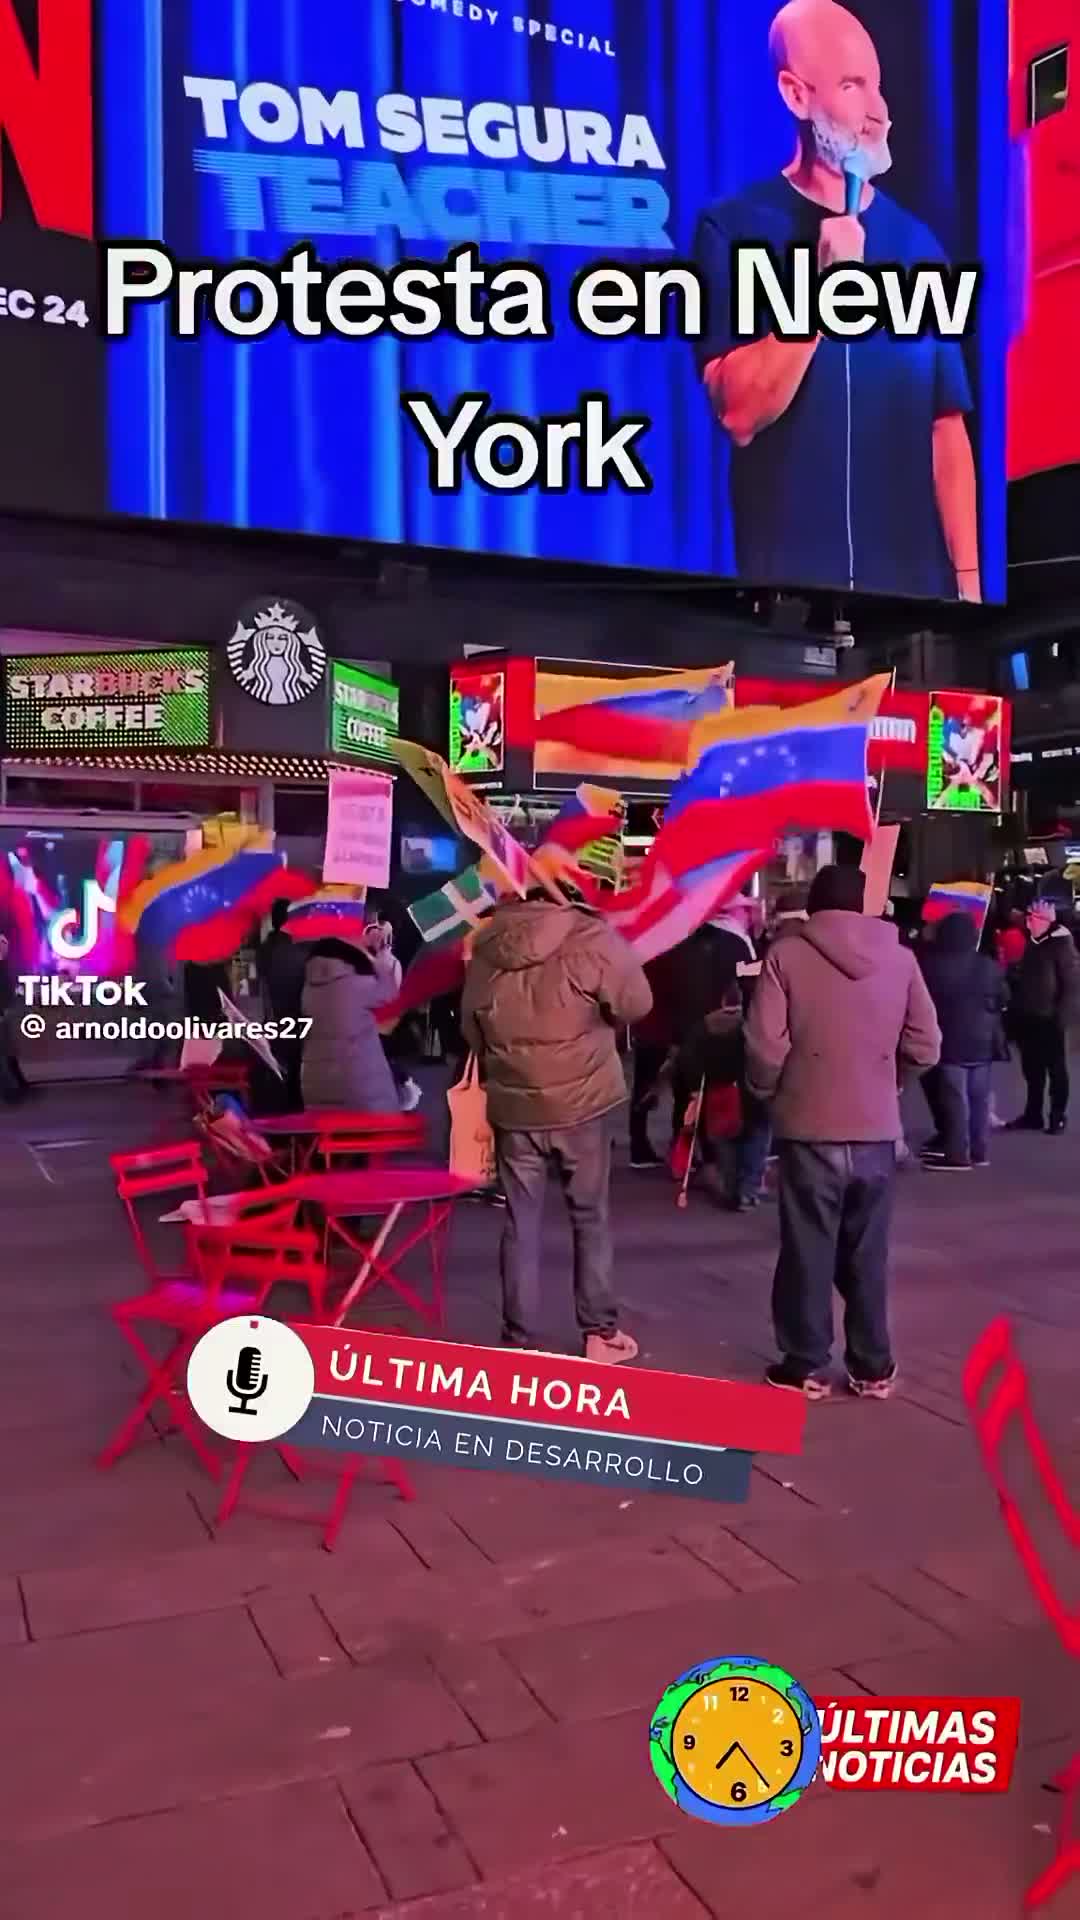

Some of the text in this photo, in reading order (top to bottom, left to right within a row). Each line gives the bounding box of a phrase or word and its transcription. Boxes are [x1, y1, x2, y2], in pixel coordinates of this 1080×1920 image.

[395, 0, 616, 57] MEDY SPECIAL
[183, 75, 667, 170] TOM SEGURA
[192, 149, 675, 249] TEACHER
[43, 295, 90, 328] 24
[9, 669, 205, 699] STARBUCKS
[42, 704, 164, 731] COFFEE
